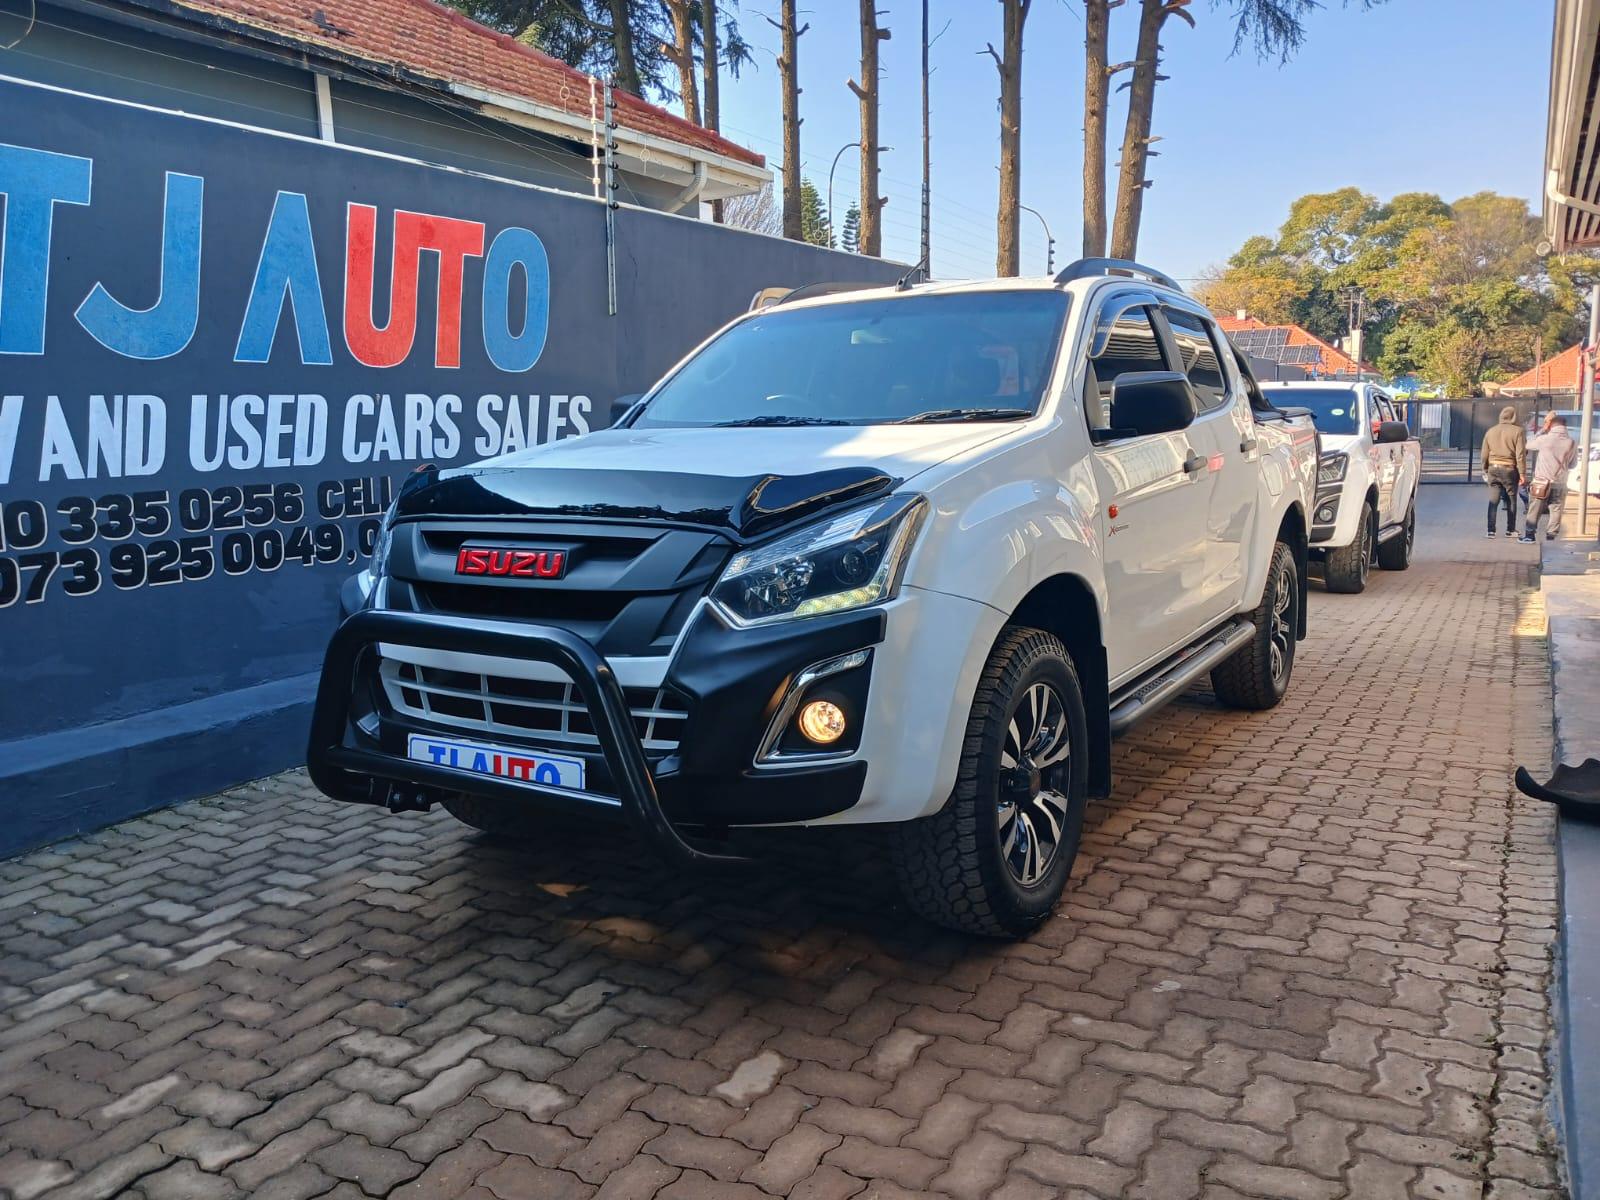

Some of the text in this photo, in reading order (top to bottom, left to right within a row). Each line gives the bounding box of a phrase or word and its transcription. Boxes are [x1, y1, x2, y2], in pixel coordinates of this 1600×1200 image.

[0, 143, 551, 373] TJ AUTO
[38, 394, 167, 482] AND
[189, 394, 329, 472] USED
[342, 393, 463, 463] CARS
[474, 394, 593, 457] SALES
[0, 500, 48, 550] 0
[57, 490, 172, 545] 335
[180, 482, 305, 533] 0256
[109, 535, 215, 591] 925
[456, 549, 565, 578] ISUZU
